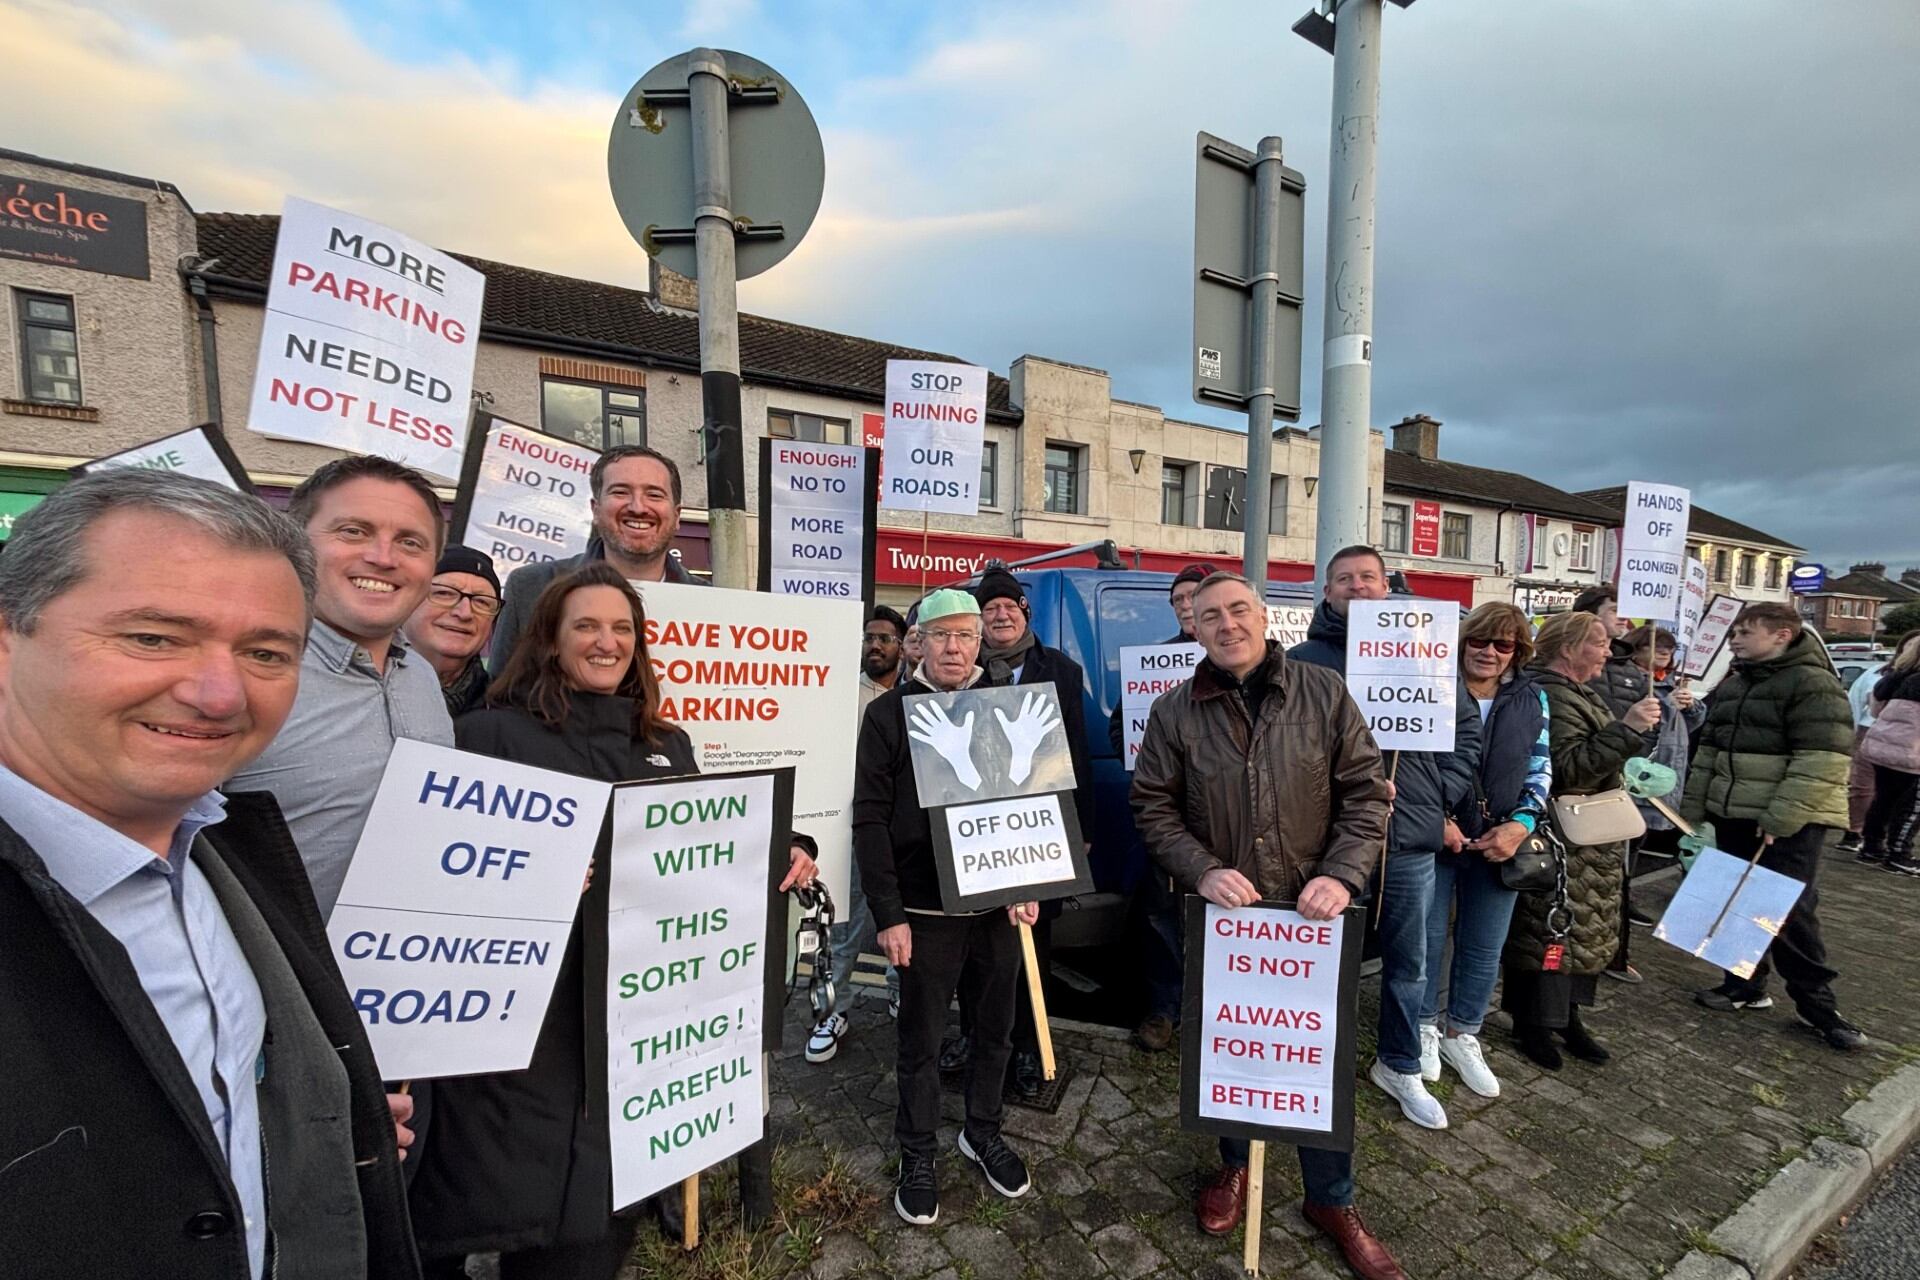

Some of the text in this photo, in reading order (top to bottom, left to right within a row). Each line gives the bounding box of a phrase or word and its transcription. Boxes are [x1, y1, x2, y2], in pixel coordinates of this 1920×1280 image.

[0, 183, 110, 232] éche
[328, 226, 446, 294] MORE
[288, 261, 467, 345] PARKING
[284, 333, 453, 404] NEEDED
[1200, 348, 1219, 361] PWS
[910, 372, 963, 393] STOP
[269, 377, 455, 449] NOT LESS
[891, 401, 978, 425] RUINING
[779, 449, 857, 469] ENOUGH!
[910, 447, 954, 468] OUR
[505, 463, 576, 498] NO TO
[790, 474, 846, 494] NO TO
[1637, 492, 1683, 513] HANDS
[496, 510, 566, 543] MORE
[790, 516, 844, 536] MORE
[1647, 520, 1673, 537] OFF
[791, 543, 843, 562] ROAD
[887, 546, 988, 576] Twomey'
[1626, 559, 1679, 575] CLONKEEN
[782, 579, 850, 598] WORKS
[1377, 612, 1434, 629] STOP
[644, 619, 808, 653] SAVE YOUR
[1358, 641, 1449, 659] RISKING
[650, 659, 830, 688] COMMUNITY
[1141, 652, 1195, 669] MORE
[1367, 686, 1438, 704] LOCAL
[660, 697, 780, 722] ARKING
[703, 742, 722, 752] Step
[704, 751, 732, 760] Google
[703, 758, 755, 768] Improvements
[418, 771, 578, 828] HANDS
[644, 794, 748, 829] DOWN
[957, 808, 1055, 838] OFF OUR
[440, 842, 531, 881] OFF
[652, 841, 735, 877] WITH
[962, 842, 1062, 873] PARKING
[655, 908, 729, 943] THIS
[1215, 918, 1332, 946] CHANGE
[343, 930, 551, 966] CLONKEEN
[618, 957, 705, 999] SORT
[719, 942, 757, 972] OF
[1228, 954, 1315, 980] IS NOT
[1216, 1003, 1322, 1031] ALWAYS
[1213, 1036, 1323, 1065] FOR THE
[622, 1056, 753, 1122] CAREFUL
